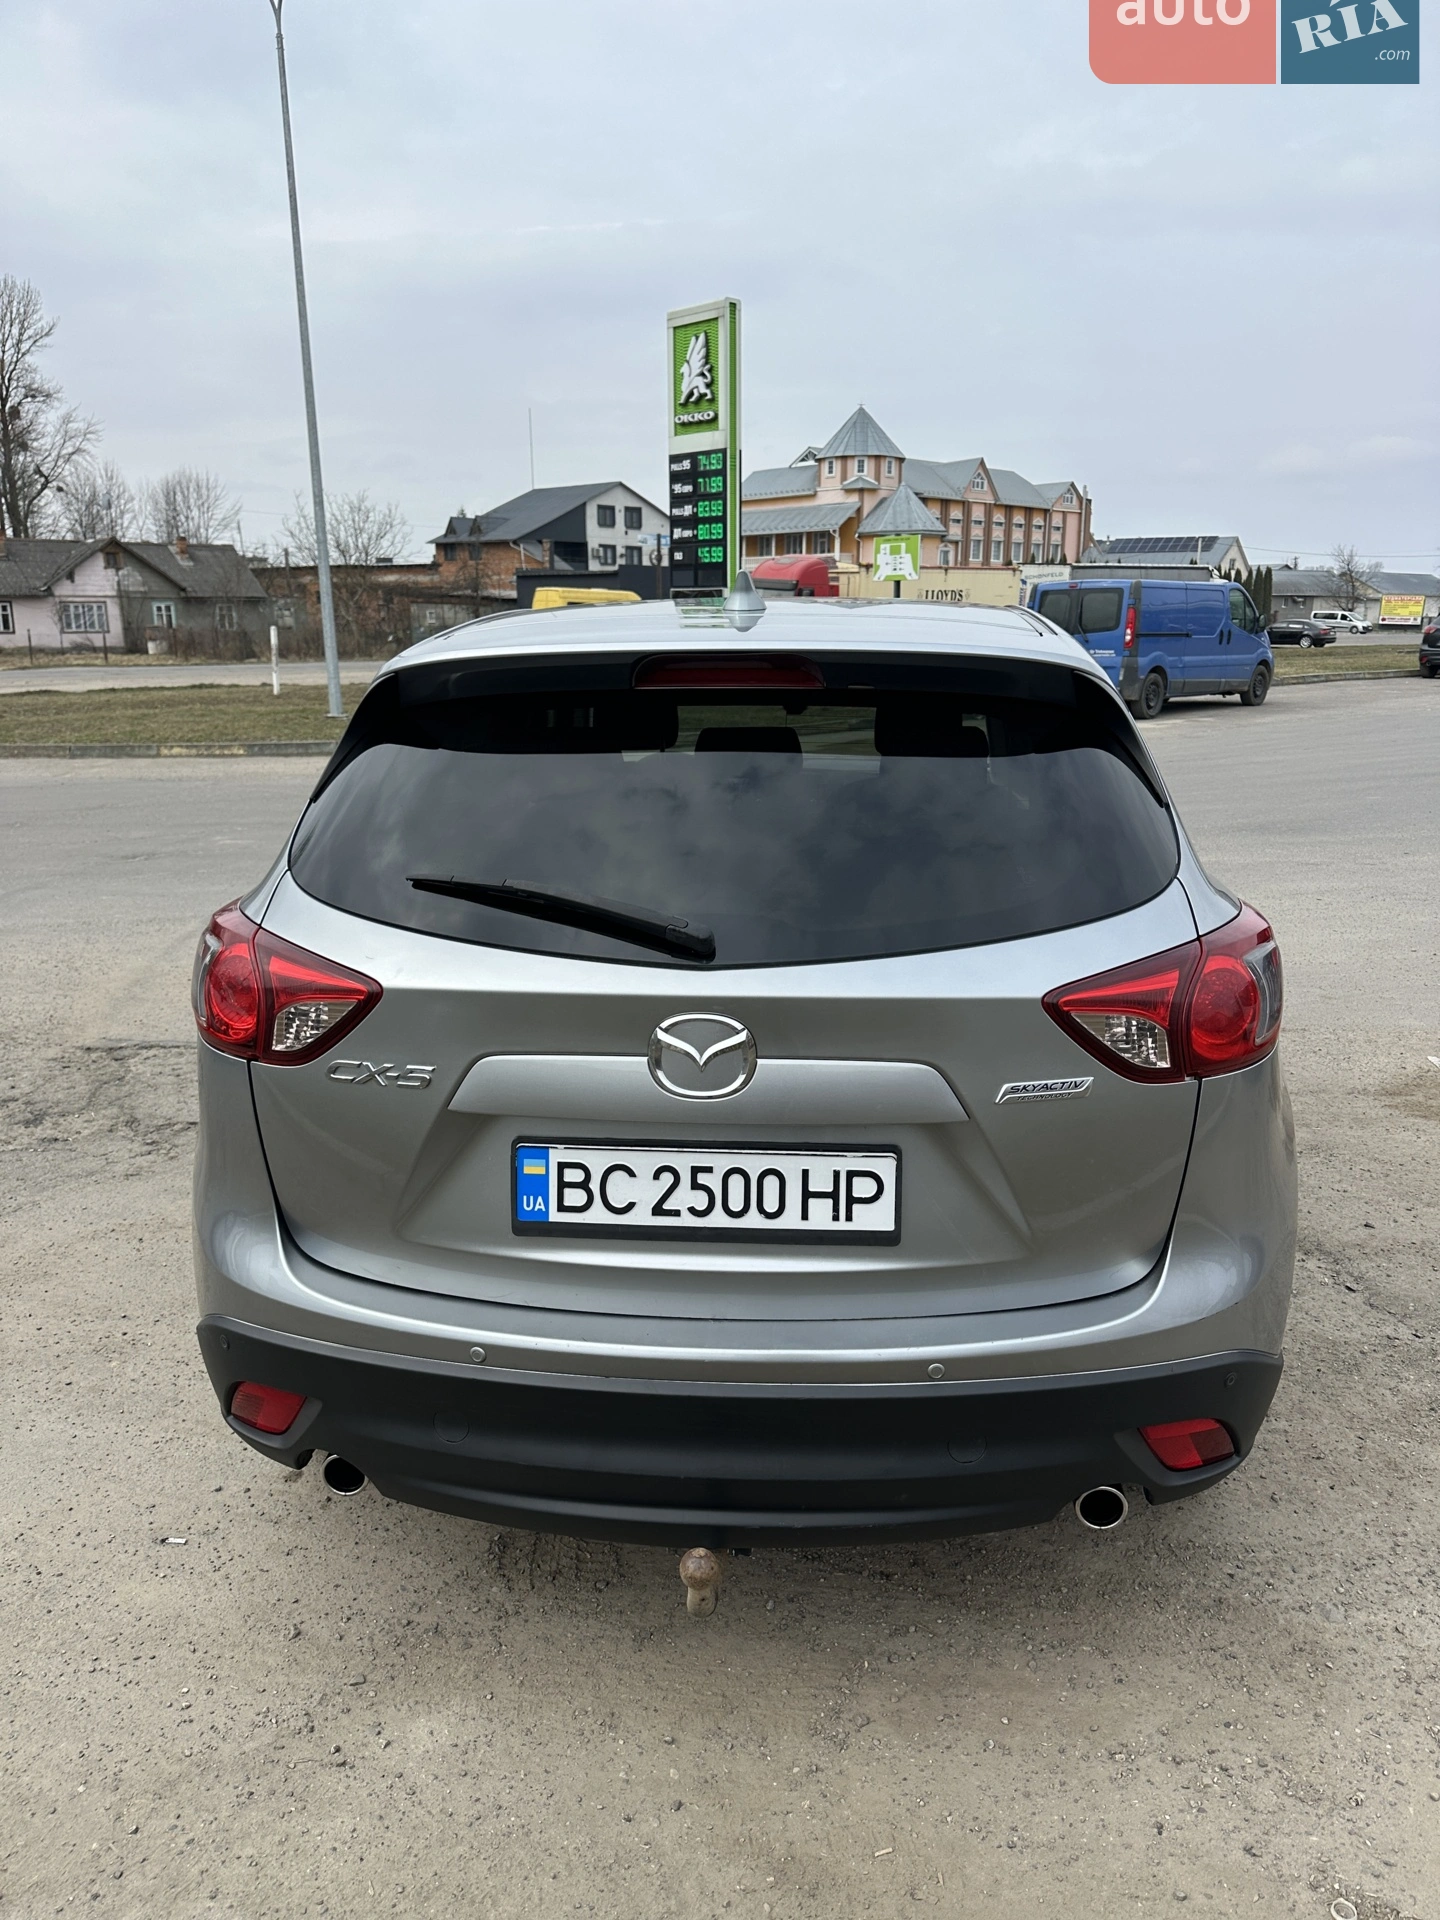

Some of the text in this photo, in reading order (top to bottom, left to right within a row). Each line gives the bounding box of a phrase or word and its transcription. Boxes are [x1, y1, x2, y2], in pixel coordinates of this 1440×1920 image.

[675, 411, 715, 423] OKKO
[326, 1059, 436, 1089] CX-5
[1009, 1080, 1085, 1094] SKYACTIV
[557, 1161, 885, 1222] BC 2500 HP
[523, 1195, 545, 1212] UA
